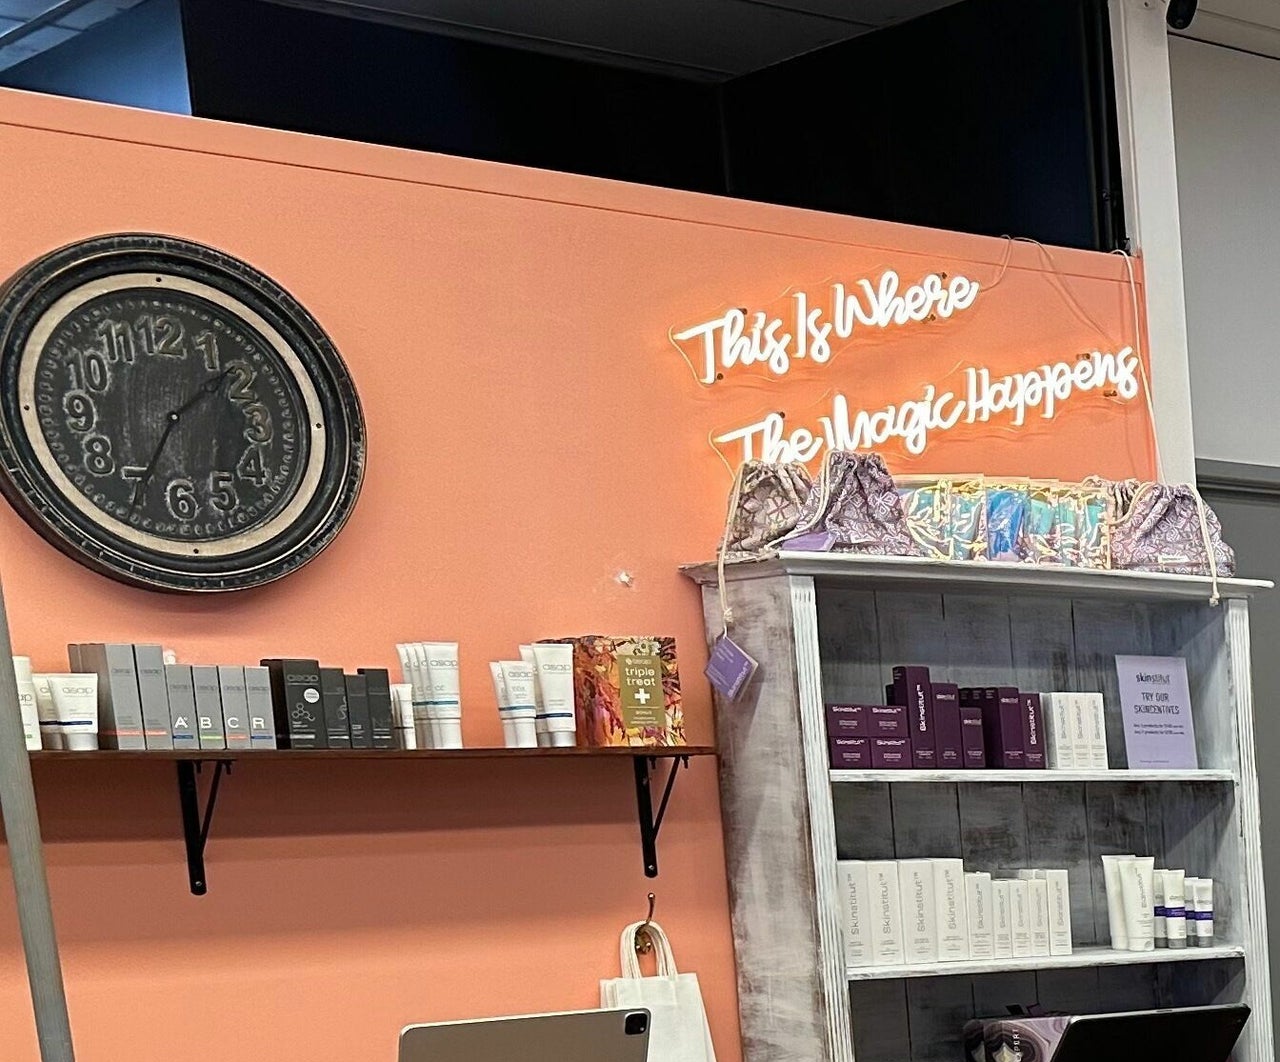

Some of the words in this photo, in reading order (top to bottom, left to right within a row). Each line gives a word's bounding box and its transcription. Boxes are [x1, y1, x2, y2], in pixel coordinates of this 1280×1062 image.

[101, 320, 135, 364] 11
[134, 315, 189, 359] 12
[673, 308, 790, 384] This
[790, 290, 832, 364] Is
[832, 268, 979, 341] Where
[66, 350, 110, 393] 10
[197, 334, 219, 371] 1
[227, 361, 257, 401] 2
[61, 390, 97, 432] 9
[244, 402, 273, 444] 3
[713, 411, 824, 463] The
[824, 393, 966, 457] Magic
[964, 343, 1140, 426] Happens
[85, 436, 116, 477] 8
[239, 443, 270, 488] 4
[121, 465, 149, 504] 7
[166, 478, 197, 520] 6
[209, 472, 239, 511] 5
[542, 663, 571, 672] asap
[625, 667, 655, 678] triple
[626, 677, 656, 686] treat
[62, 686, 94, 695] asap
[201, 717, 212, 729] B
[227, 717, 240, 728] C
[253, 717, 265, 729] R
